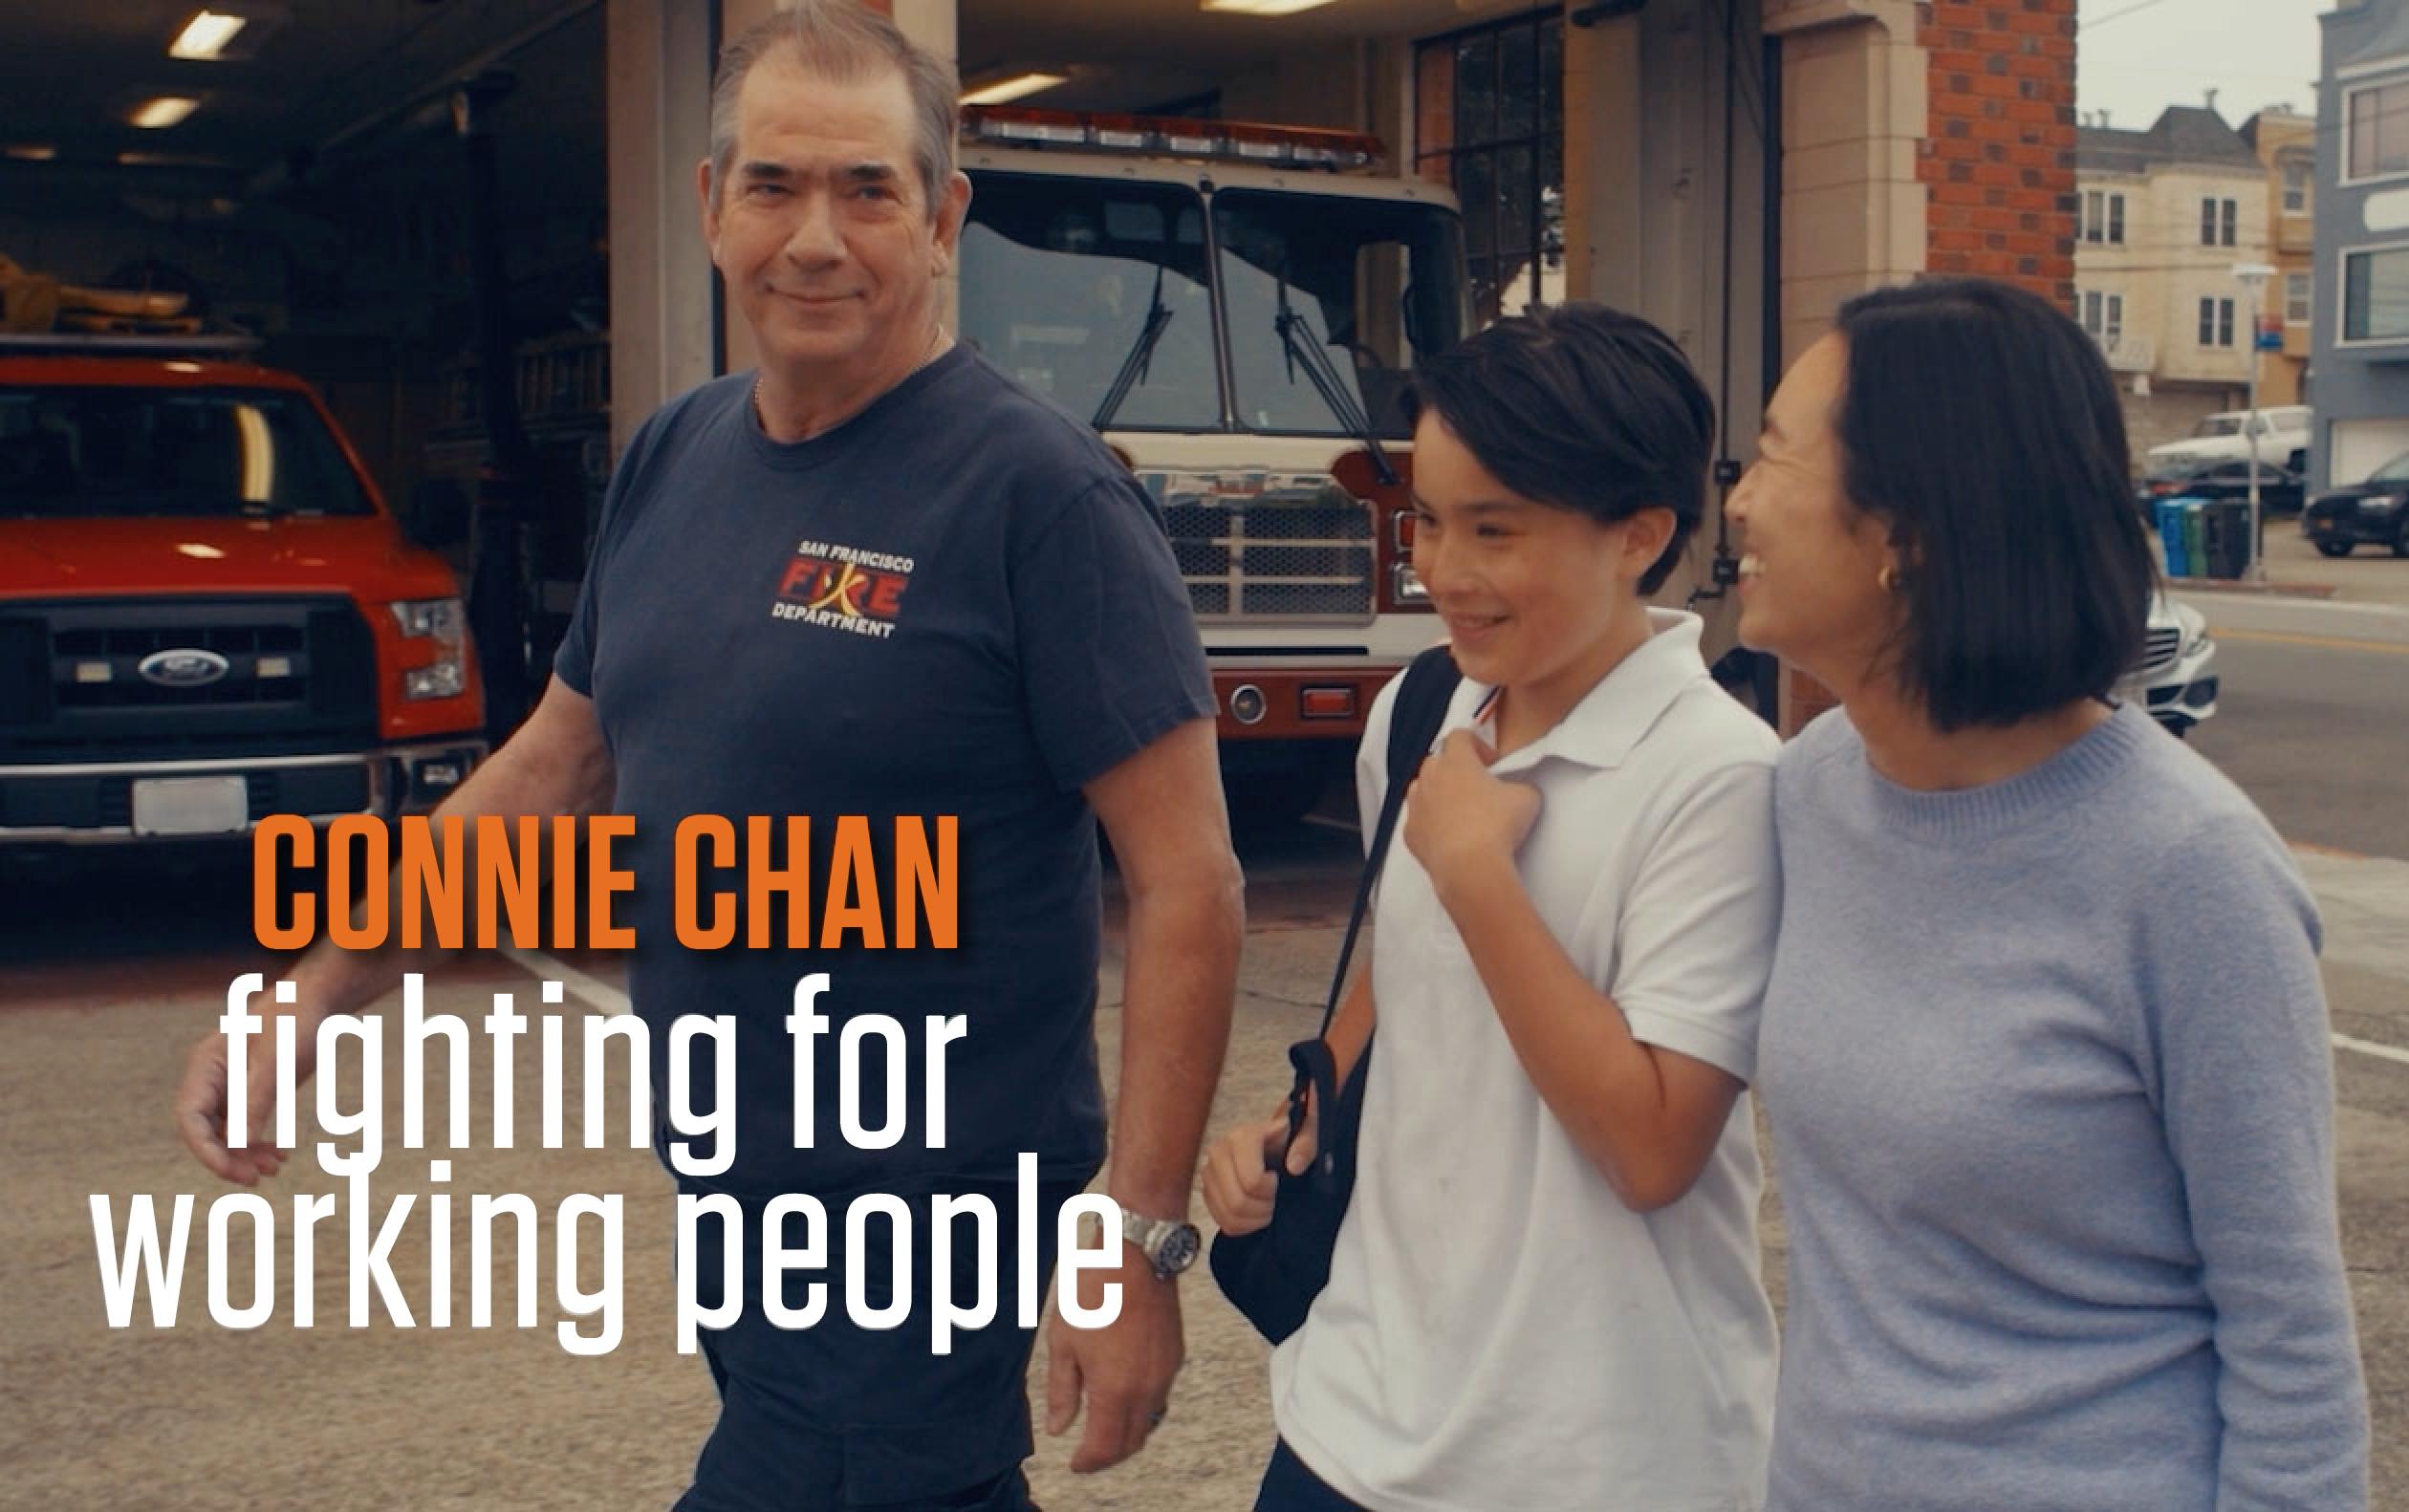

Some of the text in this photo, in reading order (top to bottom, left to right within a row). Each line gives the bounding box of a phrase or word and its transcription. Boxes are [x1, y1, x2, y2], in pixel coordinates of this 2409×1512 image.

[798, 540, 915, 573] SAN FRANCISCO
[771, 601, 896, 638] DEPARTMENT
